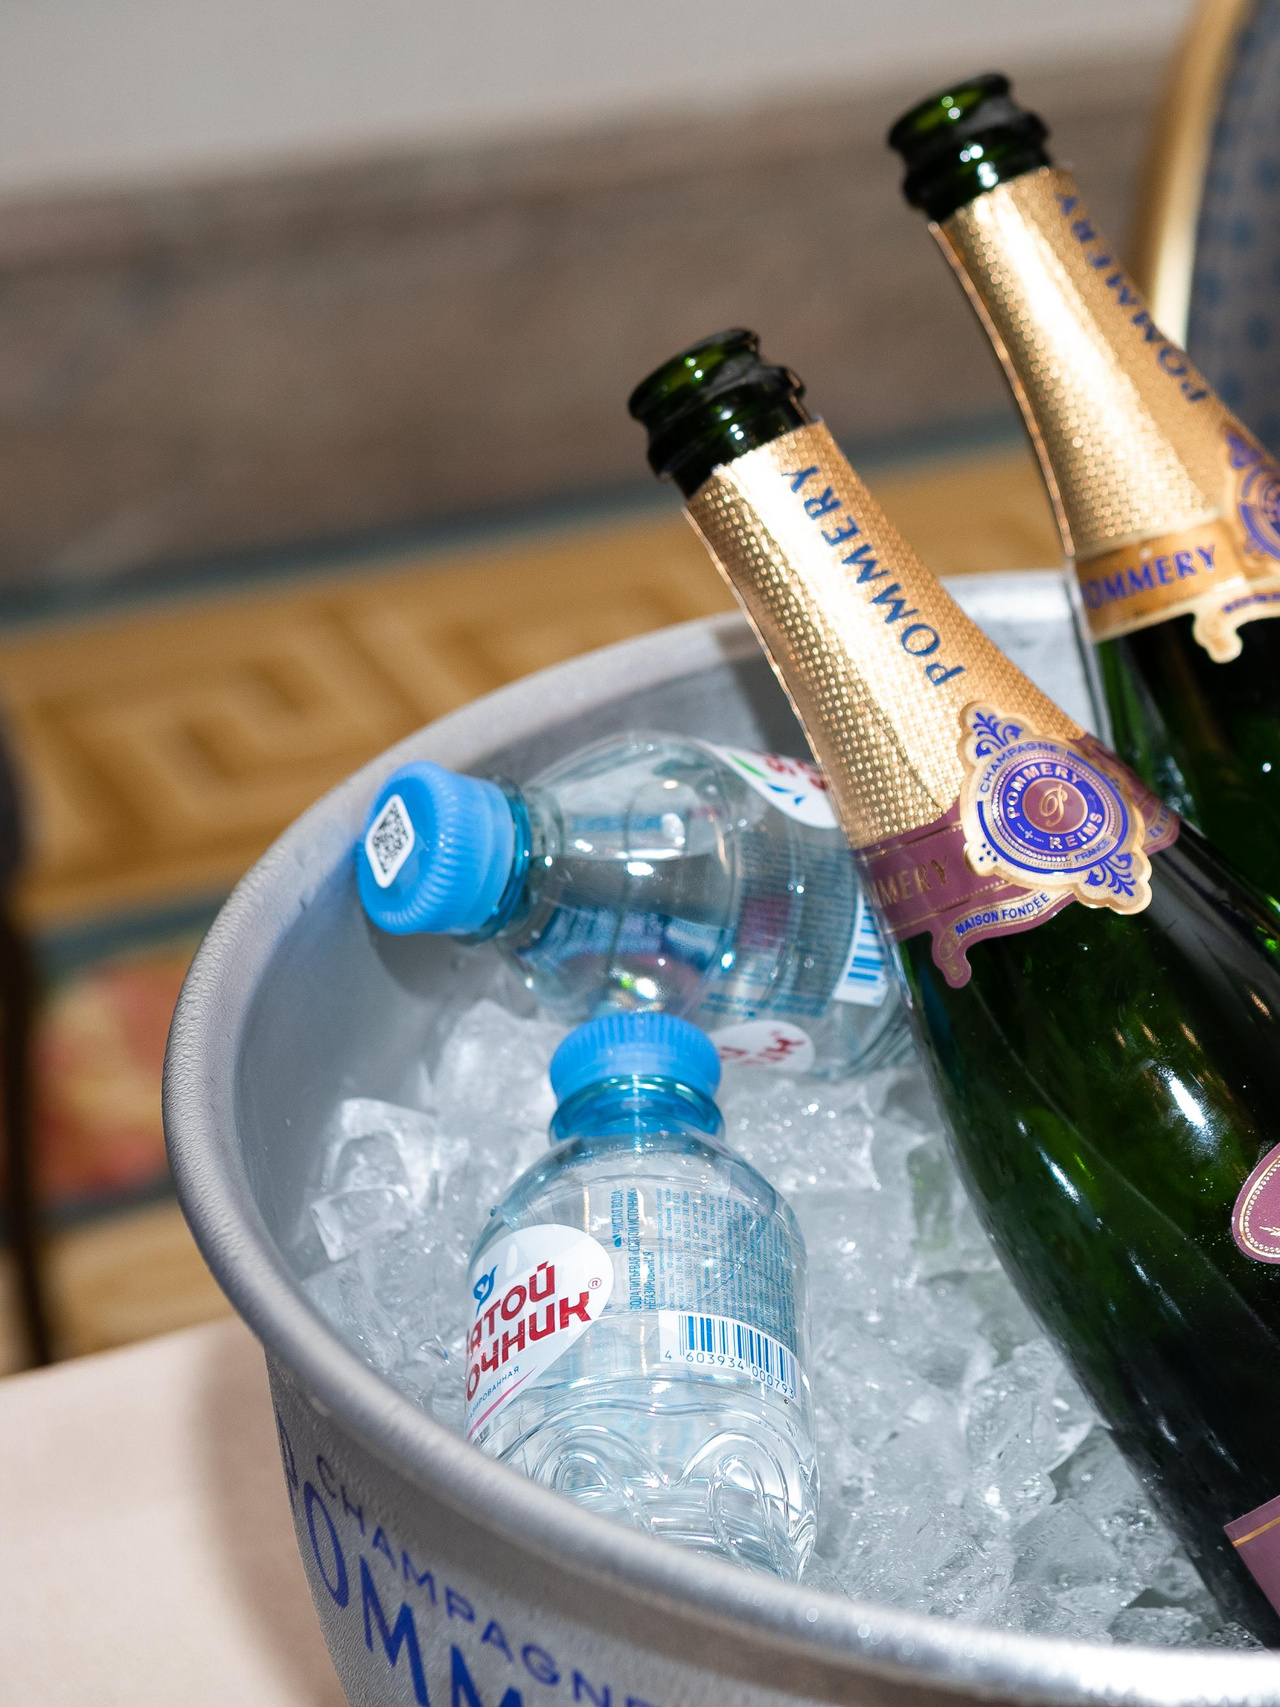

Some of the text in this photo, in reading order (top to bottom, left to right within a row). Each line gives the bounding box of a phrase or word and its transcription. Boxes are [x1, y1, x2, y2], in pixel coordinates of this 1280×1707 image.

[781, 465, 966, 687] POMMERY
[979, 742, 1061, 794] CHAMPAGNE
[1006, 763, 1083, 819] POMMERY
[1048, 811, 1103, 849] REIMS
[1074, 837, 1110, 863] FRANCE
[954, 892, 1051, 937] MAISON FONDÉE
[610, 1190, 624, 1234] ЧИСТАЯ ВОДА
[467, 1260, 555, 1356] ЯТОЙ
[630, 1291, 642, 1310] ВОДА
[664, 1350, 797, 1400] 4 603934 000793
[316, 1454, 657, 1707] CHAMPAGN
